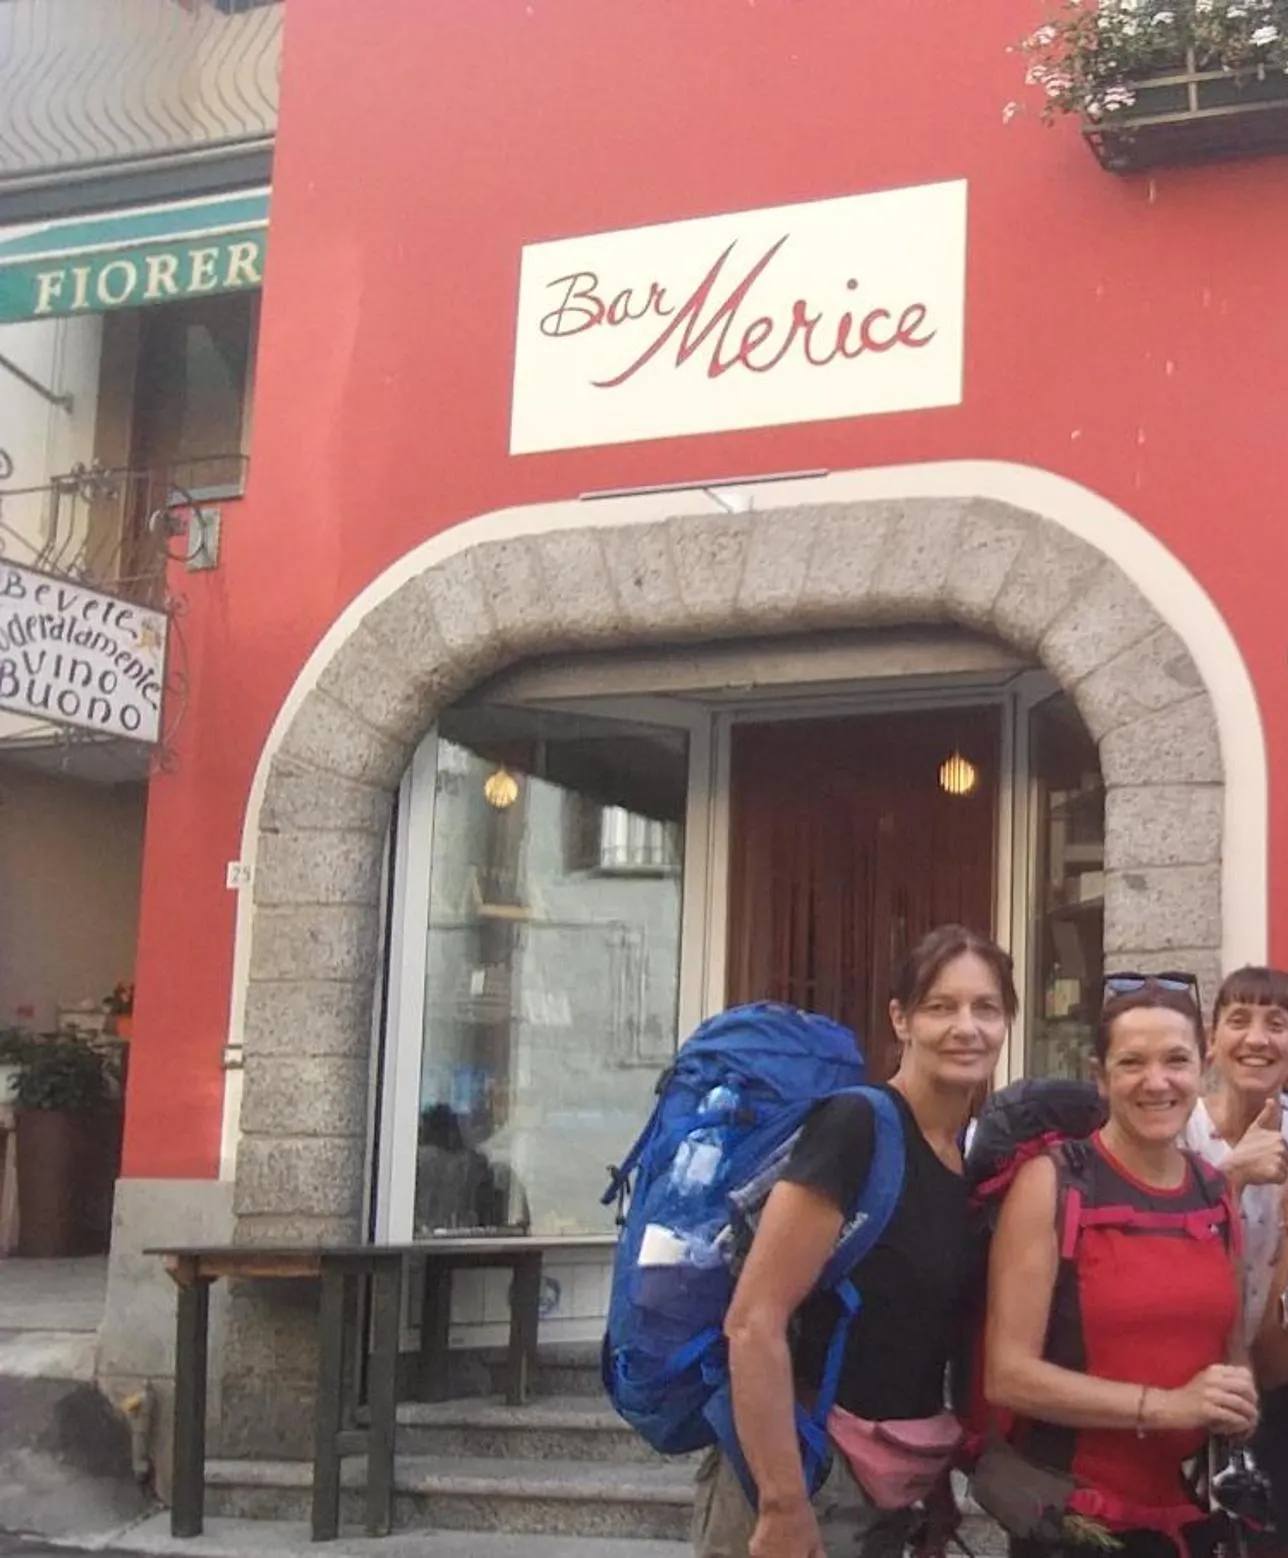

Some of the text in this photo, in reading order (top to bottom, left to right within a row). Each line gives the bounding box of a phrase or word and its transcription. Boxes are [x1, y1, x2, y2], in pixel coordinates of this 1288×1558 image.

[34, 241, 262, 315] FIORER
[540, 233, 937, 389] Bar Merice
[0, 570, 138, 639] Bevete
